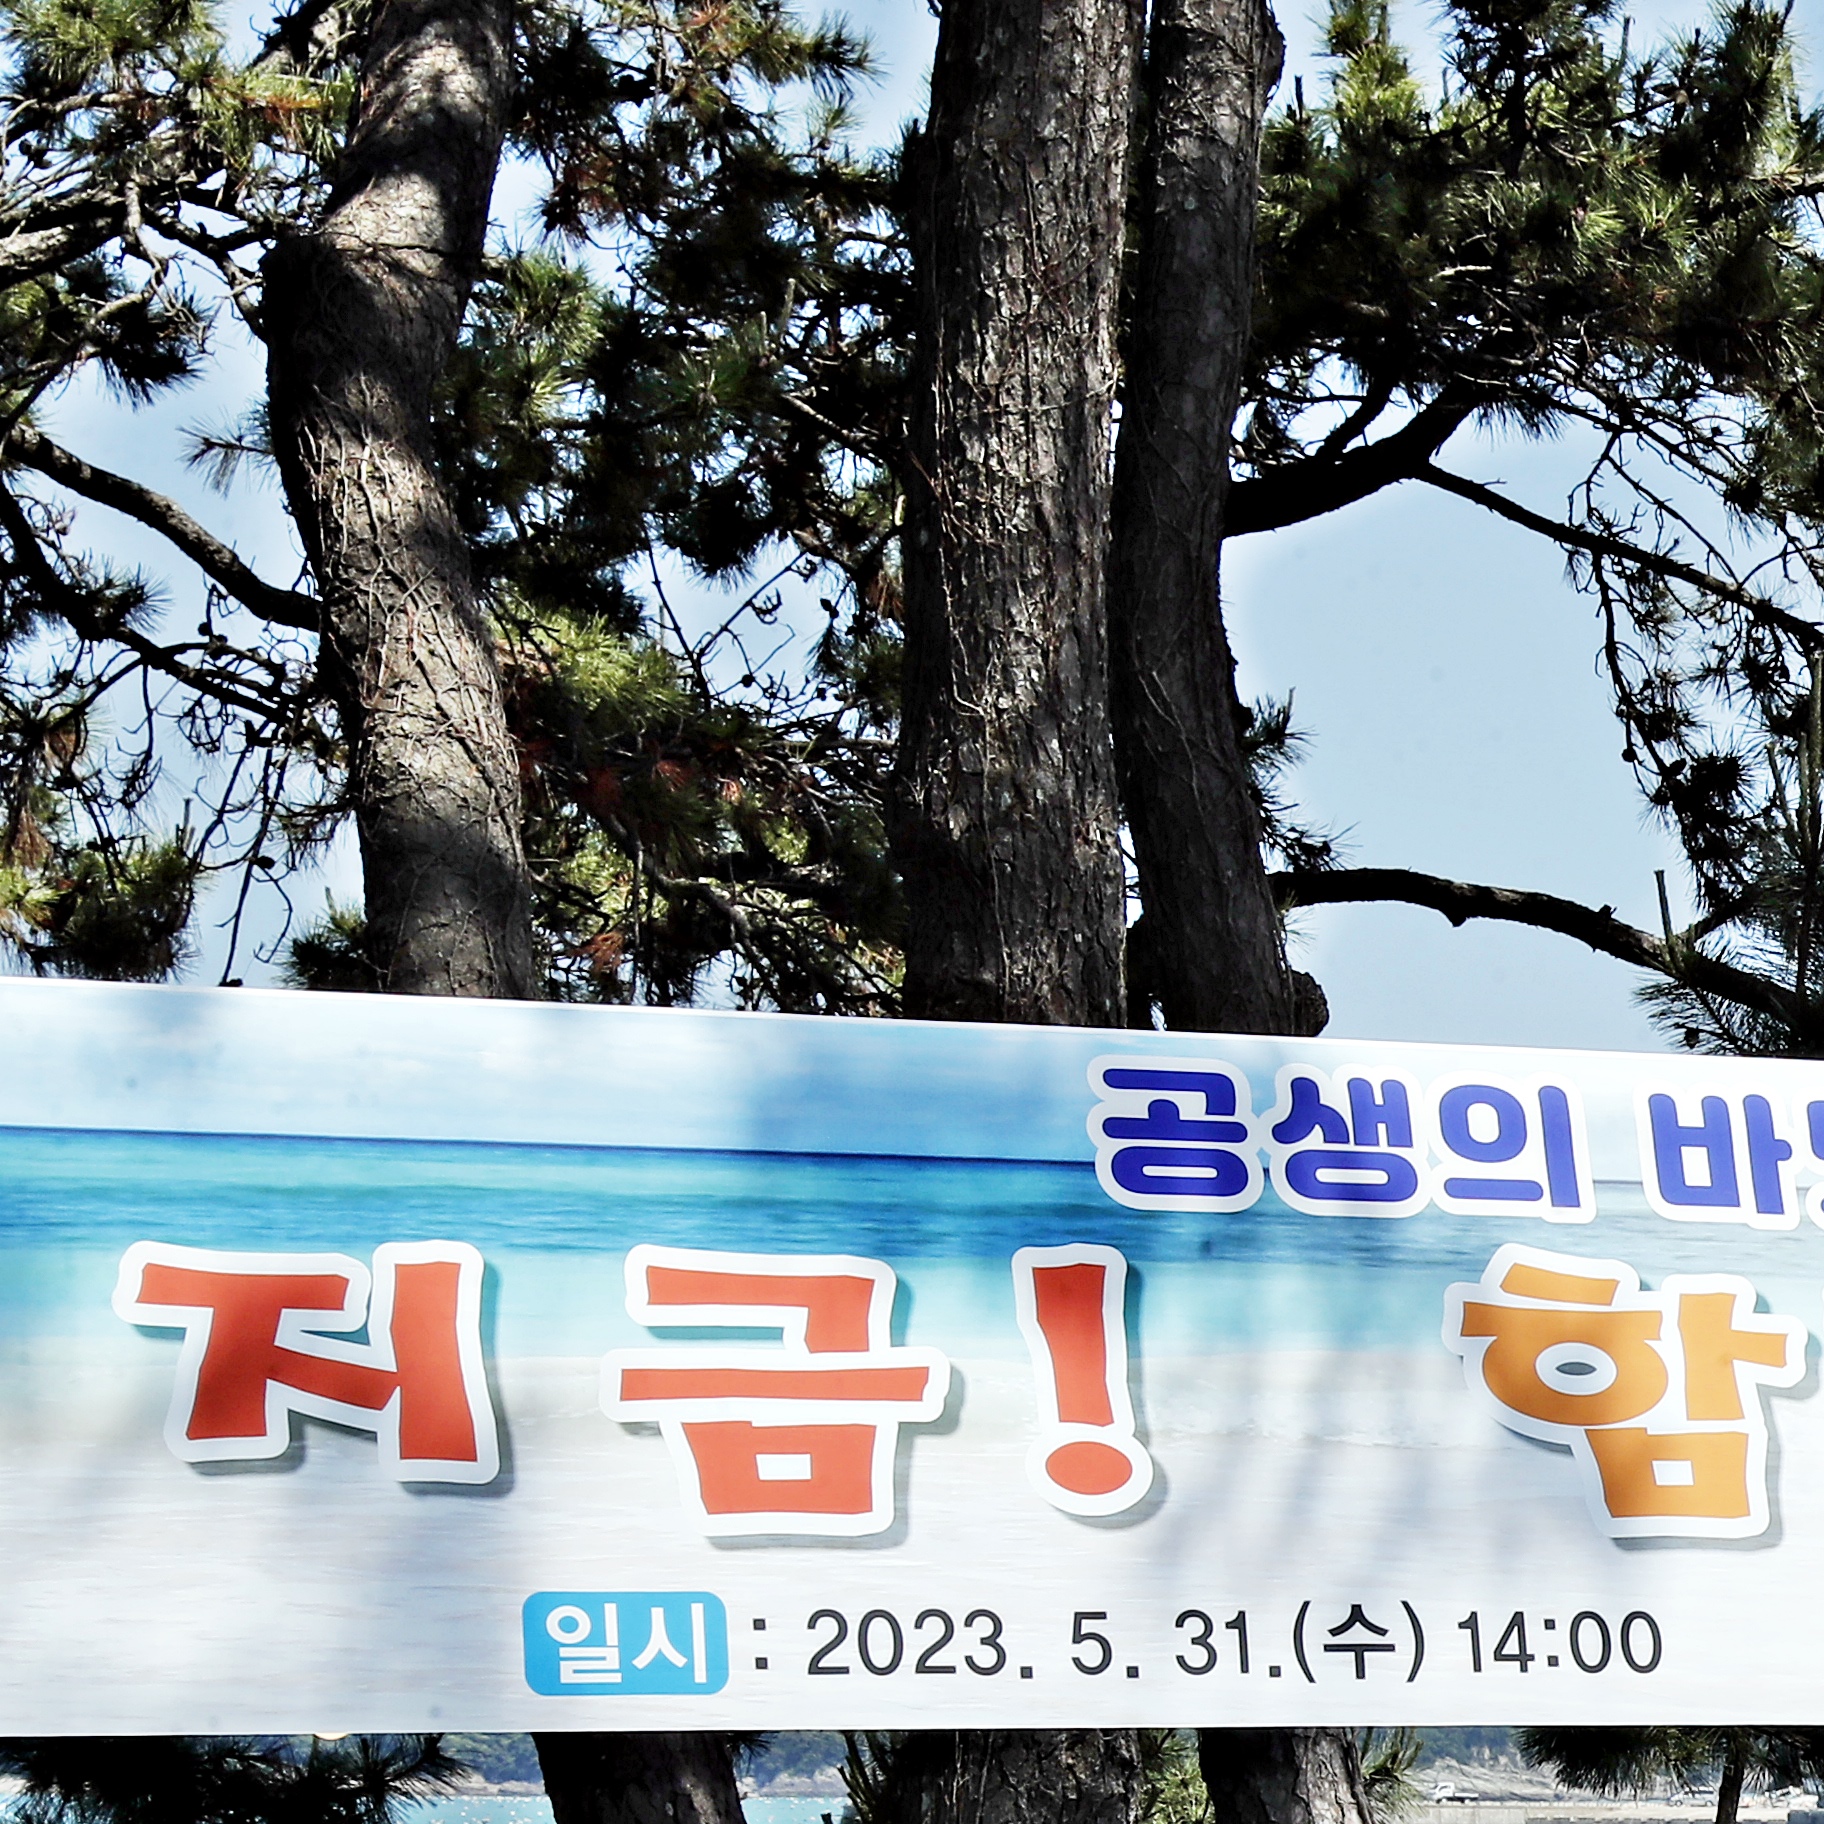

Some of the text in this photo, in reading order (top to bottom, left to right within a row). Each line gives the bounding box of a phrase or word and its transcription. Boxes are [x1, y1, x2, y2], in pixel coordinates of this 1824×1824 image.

[1100, 1064, 1582, 1210] 공생의
[543, 1600, 710, 1687] 일시
[804, 1606, 1034, 1681] 2023.
[1068, 1609, 1141, 1680] 5.
[1173, 1600, 1428, 1684] 31.(수)
[1456, 1608, 1663, 1676] 14:00
